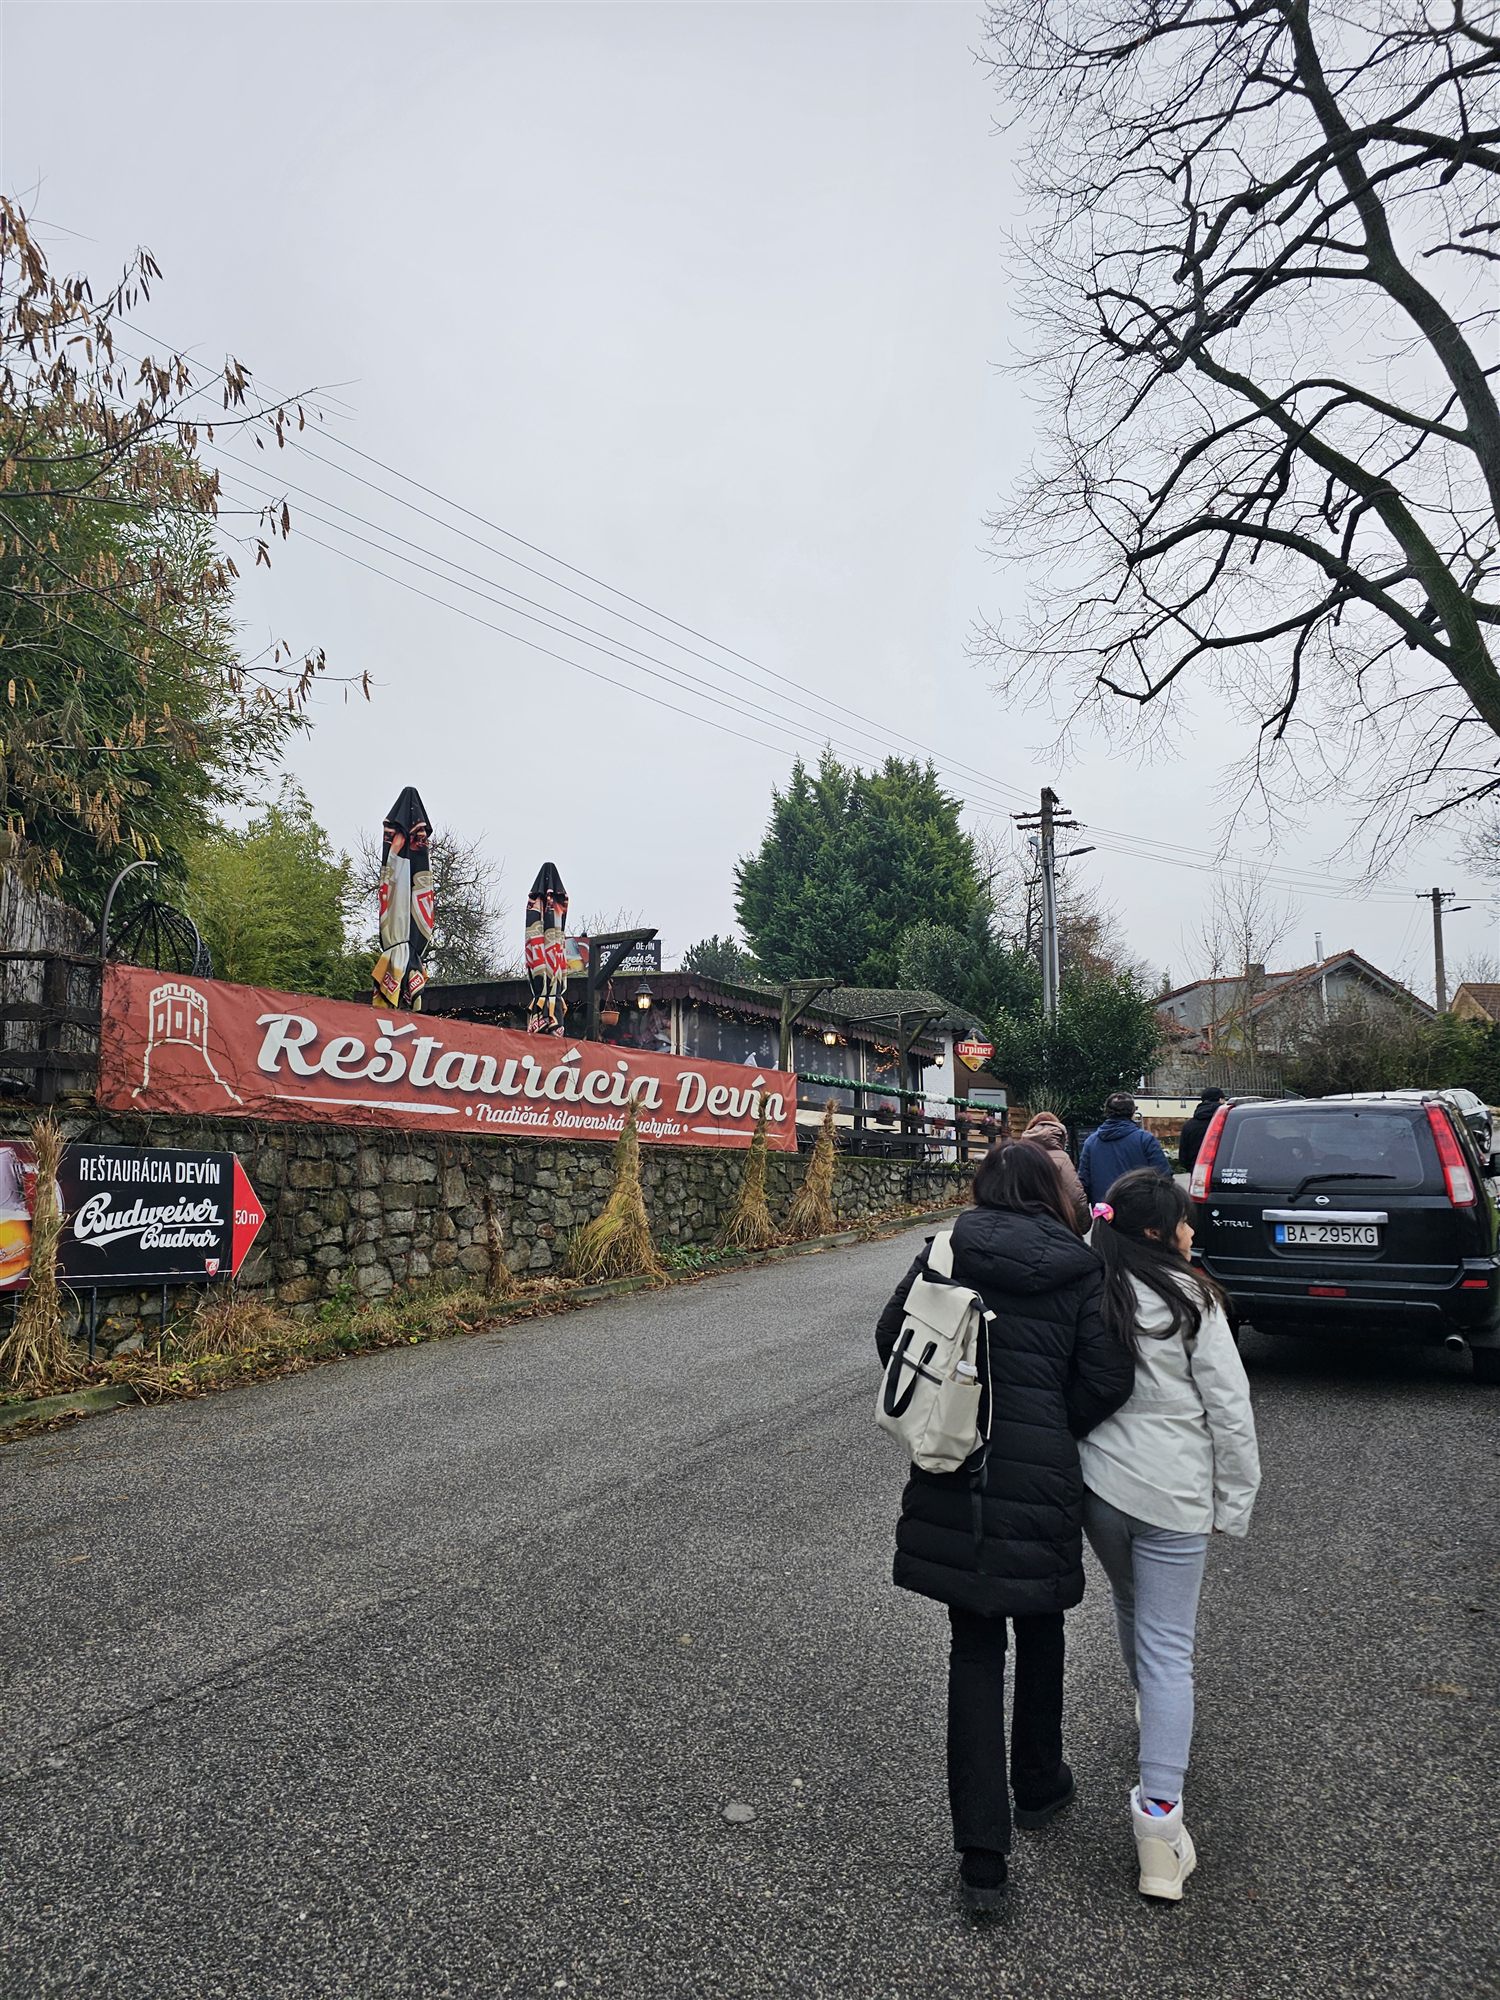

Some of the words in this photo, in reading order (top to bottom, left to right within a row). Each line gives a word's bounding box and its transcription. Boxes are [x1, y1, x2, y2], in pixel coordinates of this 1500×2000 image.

[958, 1043, 992, 1056] Urpiner
[256, 1013, 663, 1110] Reštaurácia
[675, 1071, 787, 1122] Devín
[476, 1103, 549, 1125] Tradičná
[552, 1110, 625, 1131] Slovenská
[633, 1117, 681, 1139] uchyňa
[79, 1155, 172, 1183] REŠTAURÁCIA
[175, 1158, 221, 1185] DEVÍN
[73, 1192, 225, 1240] Budweiser
[1212, 1219, 1253, 1228] X-TRAIL
[140, 1222, 221, 1250] Budvar
[1286, 1225, 1376, 1244] BA-295KG
